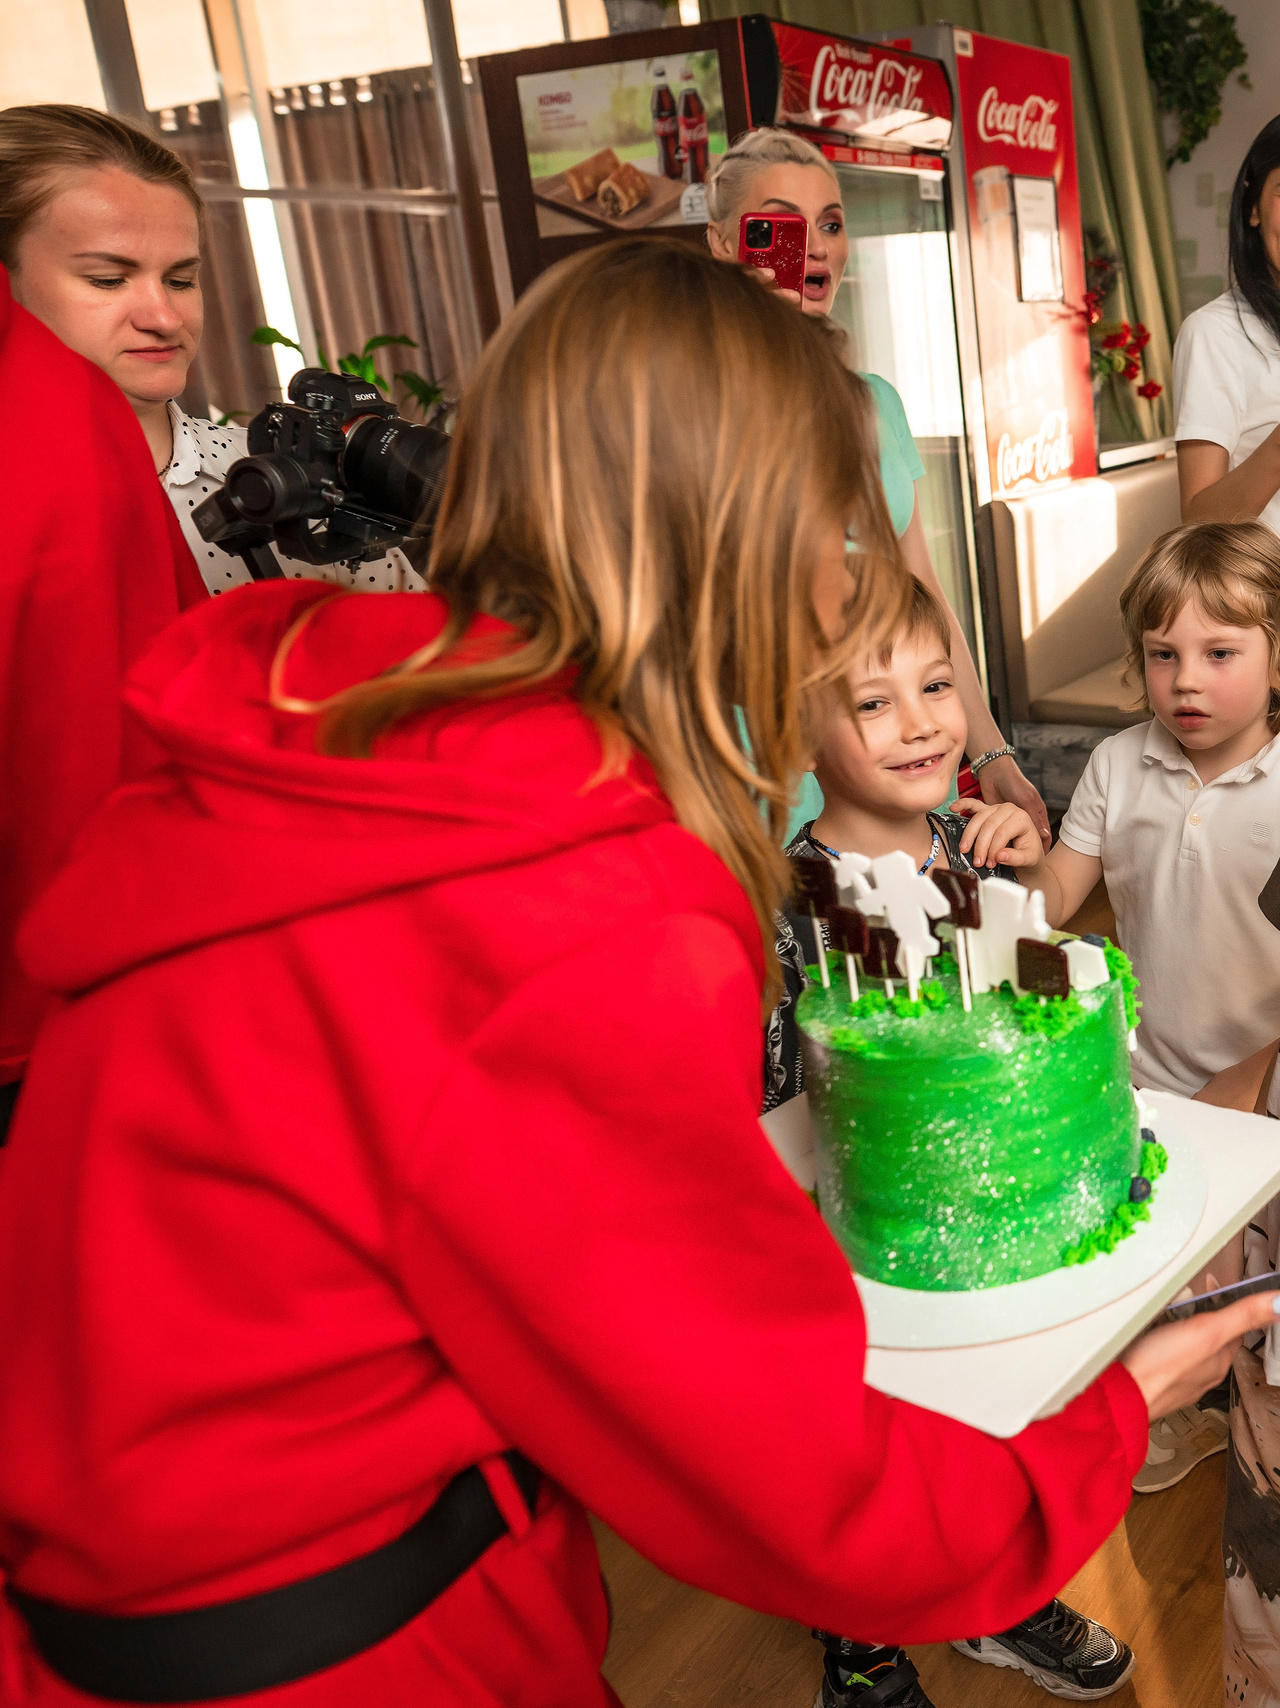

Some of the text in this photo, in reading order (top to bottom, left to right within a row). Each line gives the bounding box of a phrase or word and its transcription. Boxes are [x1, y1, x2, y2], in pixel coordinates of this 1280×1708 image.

[809, 45, 923, 124] Coca-Cola
[977, 86, 1060, 151] Coca-Cola
[354, 393, 377, 401] SONY
